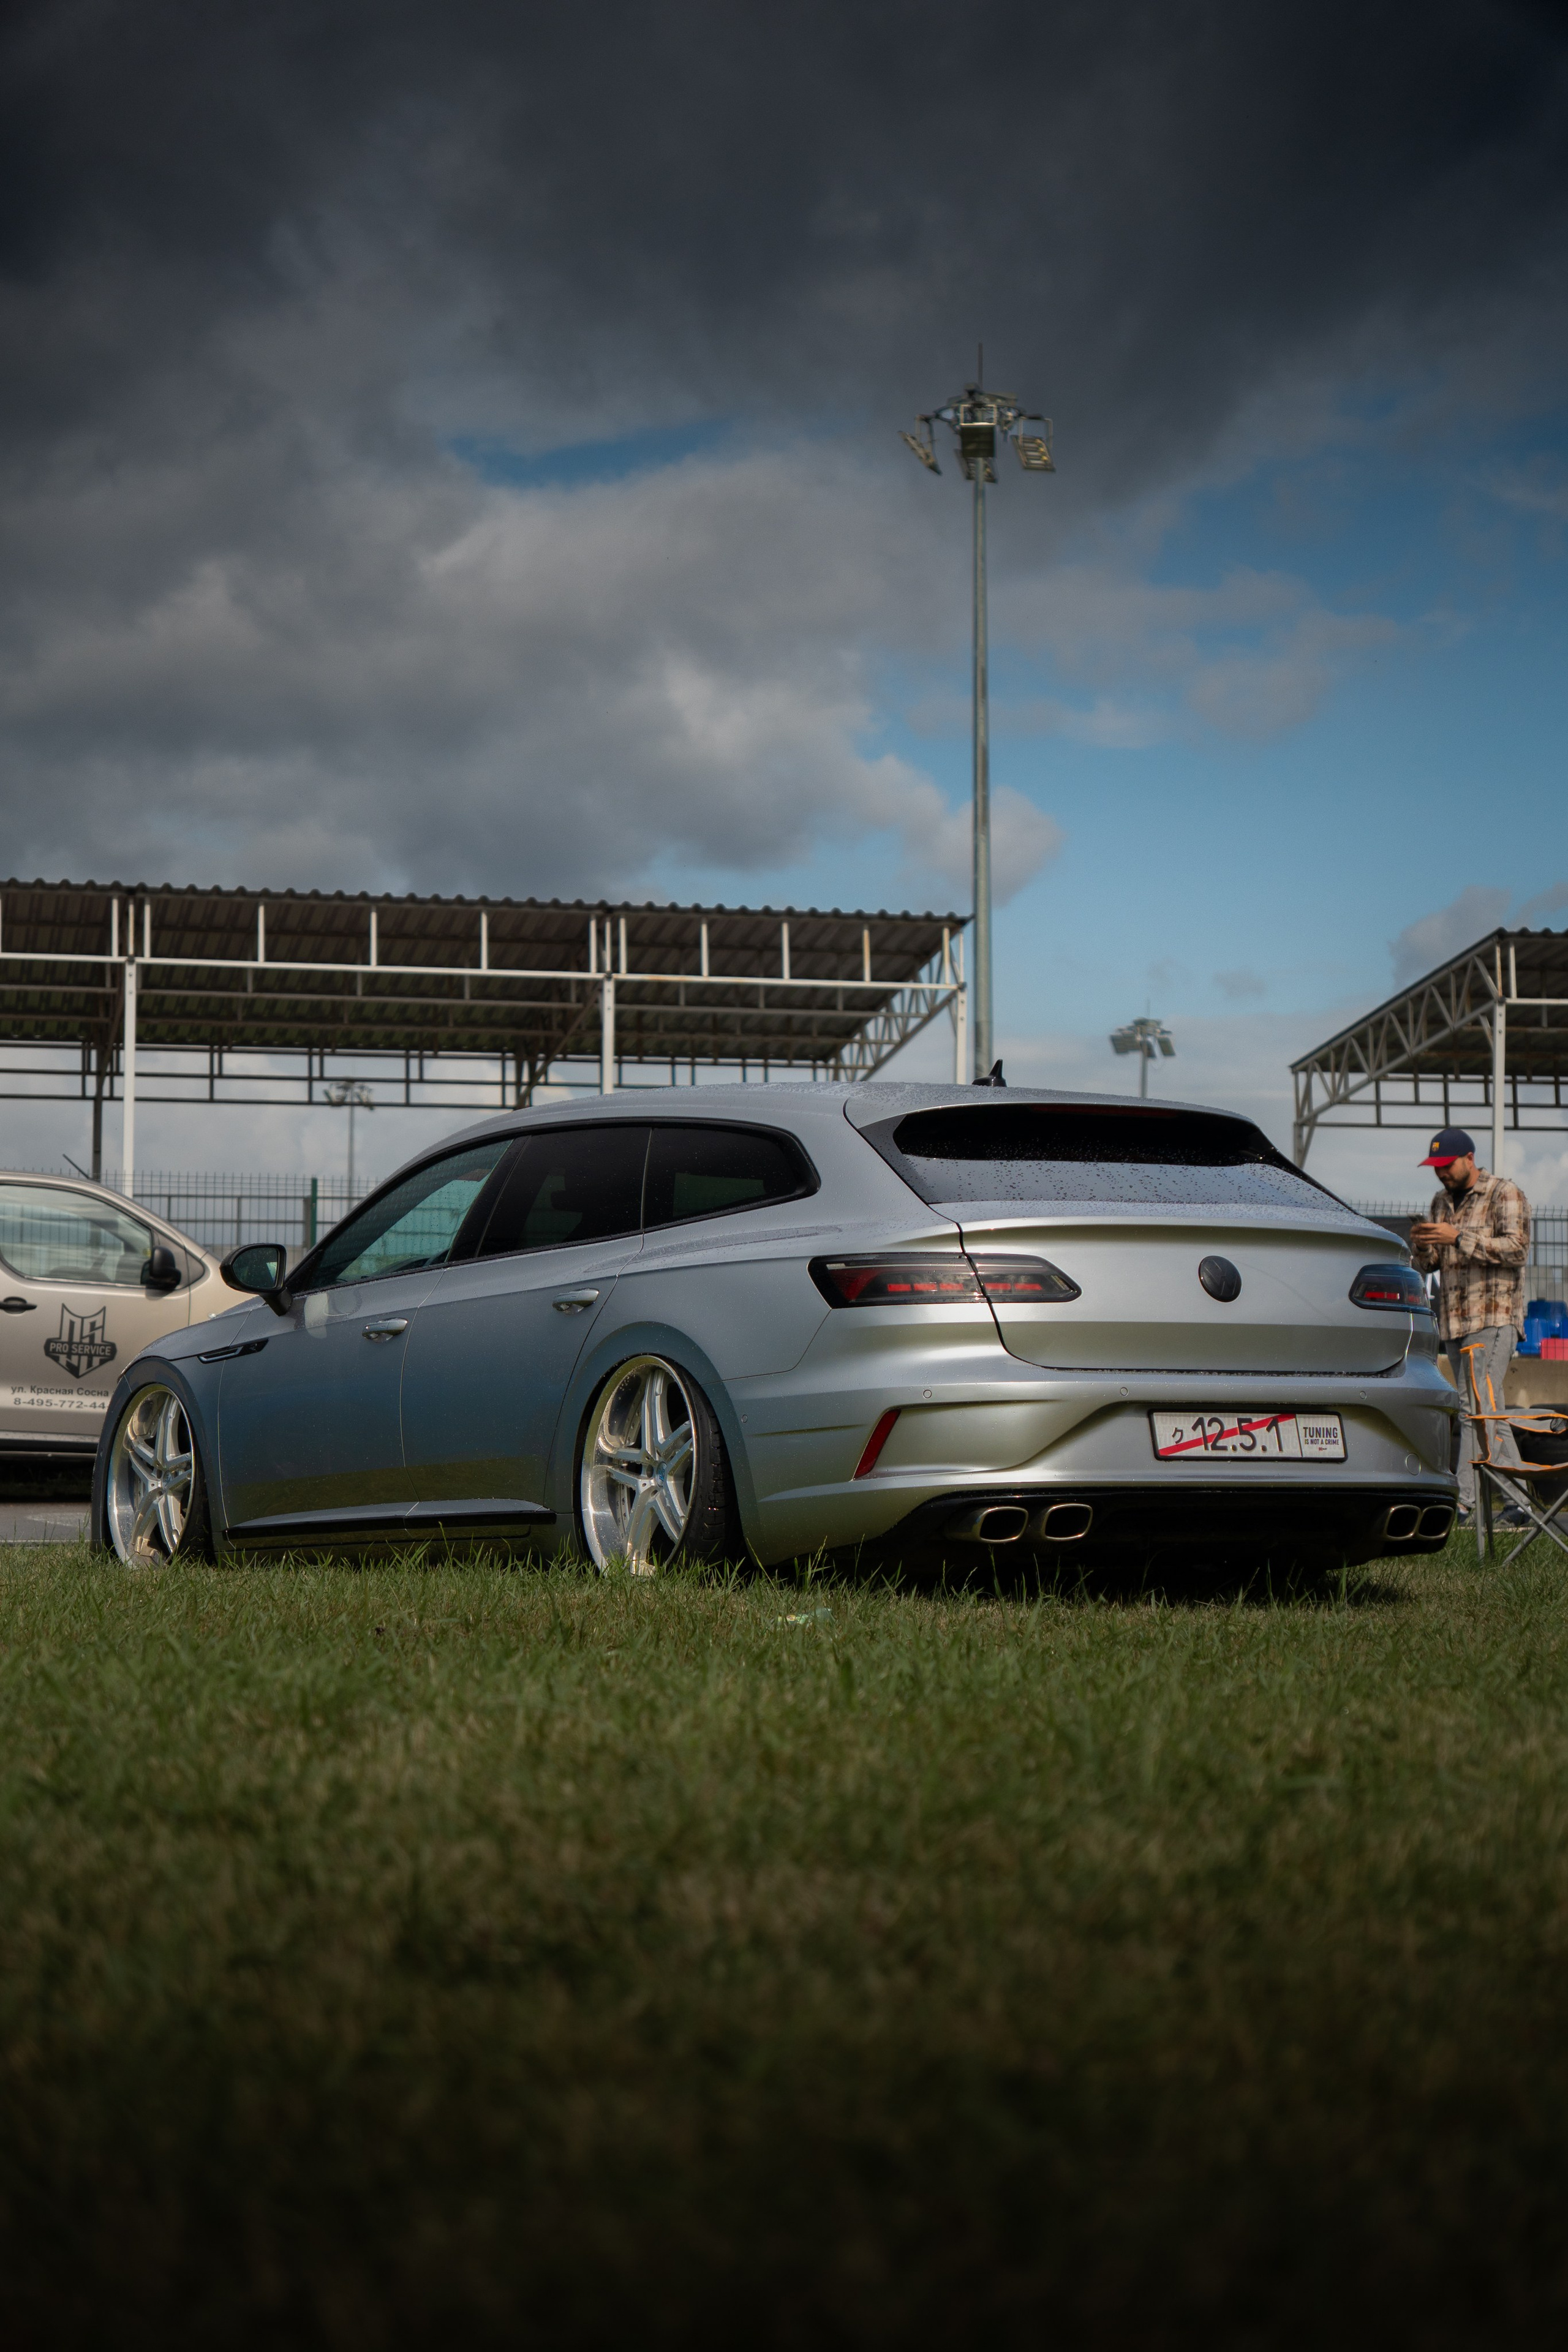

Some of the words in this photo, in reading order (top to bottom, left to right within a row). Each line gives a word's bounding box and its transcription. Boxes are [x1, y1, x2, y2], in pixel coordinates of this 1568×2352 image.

[50, 1342, 69, 1353] PRO
[71, 1344, 111, 1355] SERVICE
[11, 1385, 26, 1394] ул.
[30, 1385, 74, 1395] Красная
[77, 1387, 109, 1396] Сосна
[1191, 1417, 1284, 1452] 12.5.1
[1303, 1427, 1338, 1438] TUNING
